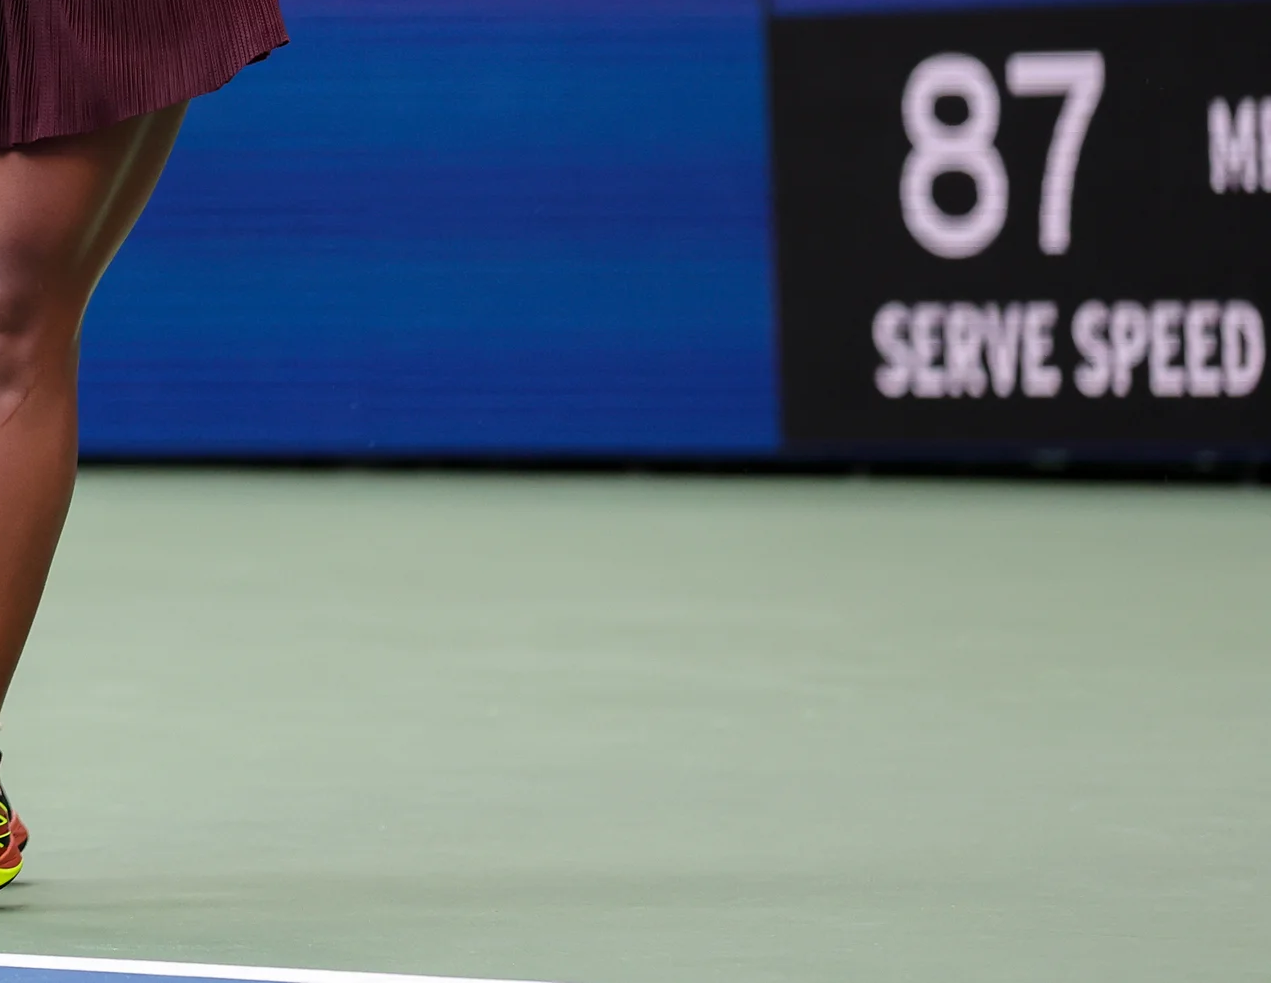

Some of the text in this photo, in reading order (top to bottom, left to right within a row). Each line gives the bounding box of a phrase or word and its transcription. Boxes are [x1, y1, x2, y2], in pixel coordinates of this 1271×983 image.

[900, 50, 1107, 260] 87
[871, 298, 1266, 399] SERVE SPEED
